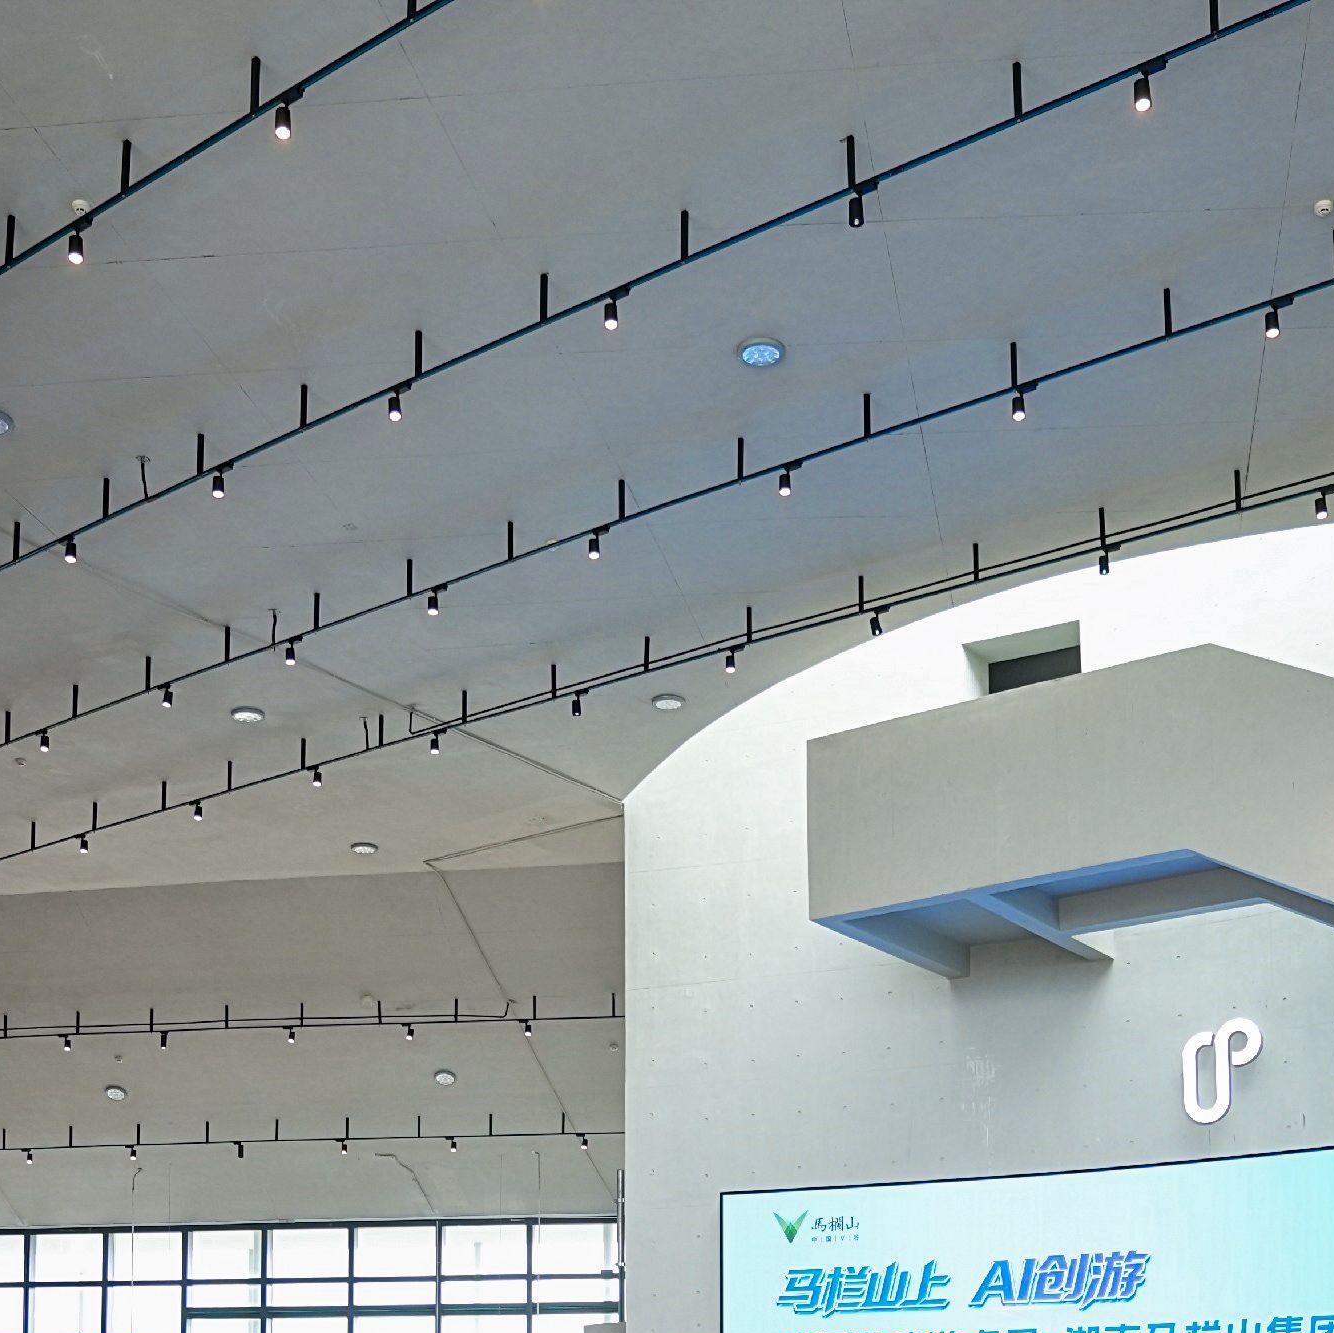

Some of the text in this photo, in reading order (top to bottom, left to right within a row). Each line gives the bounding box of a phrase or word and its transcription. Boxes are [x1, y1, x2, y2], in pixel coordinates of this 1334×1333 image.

[776, 1250, 1153, 1318] 马栏山上 AI创游
